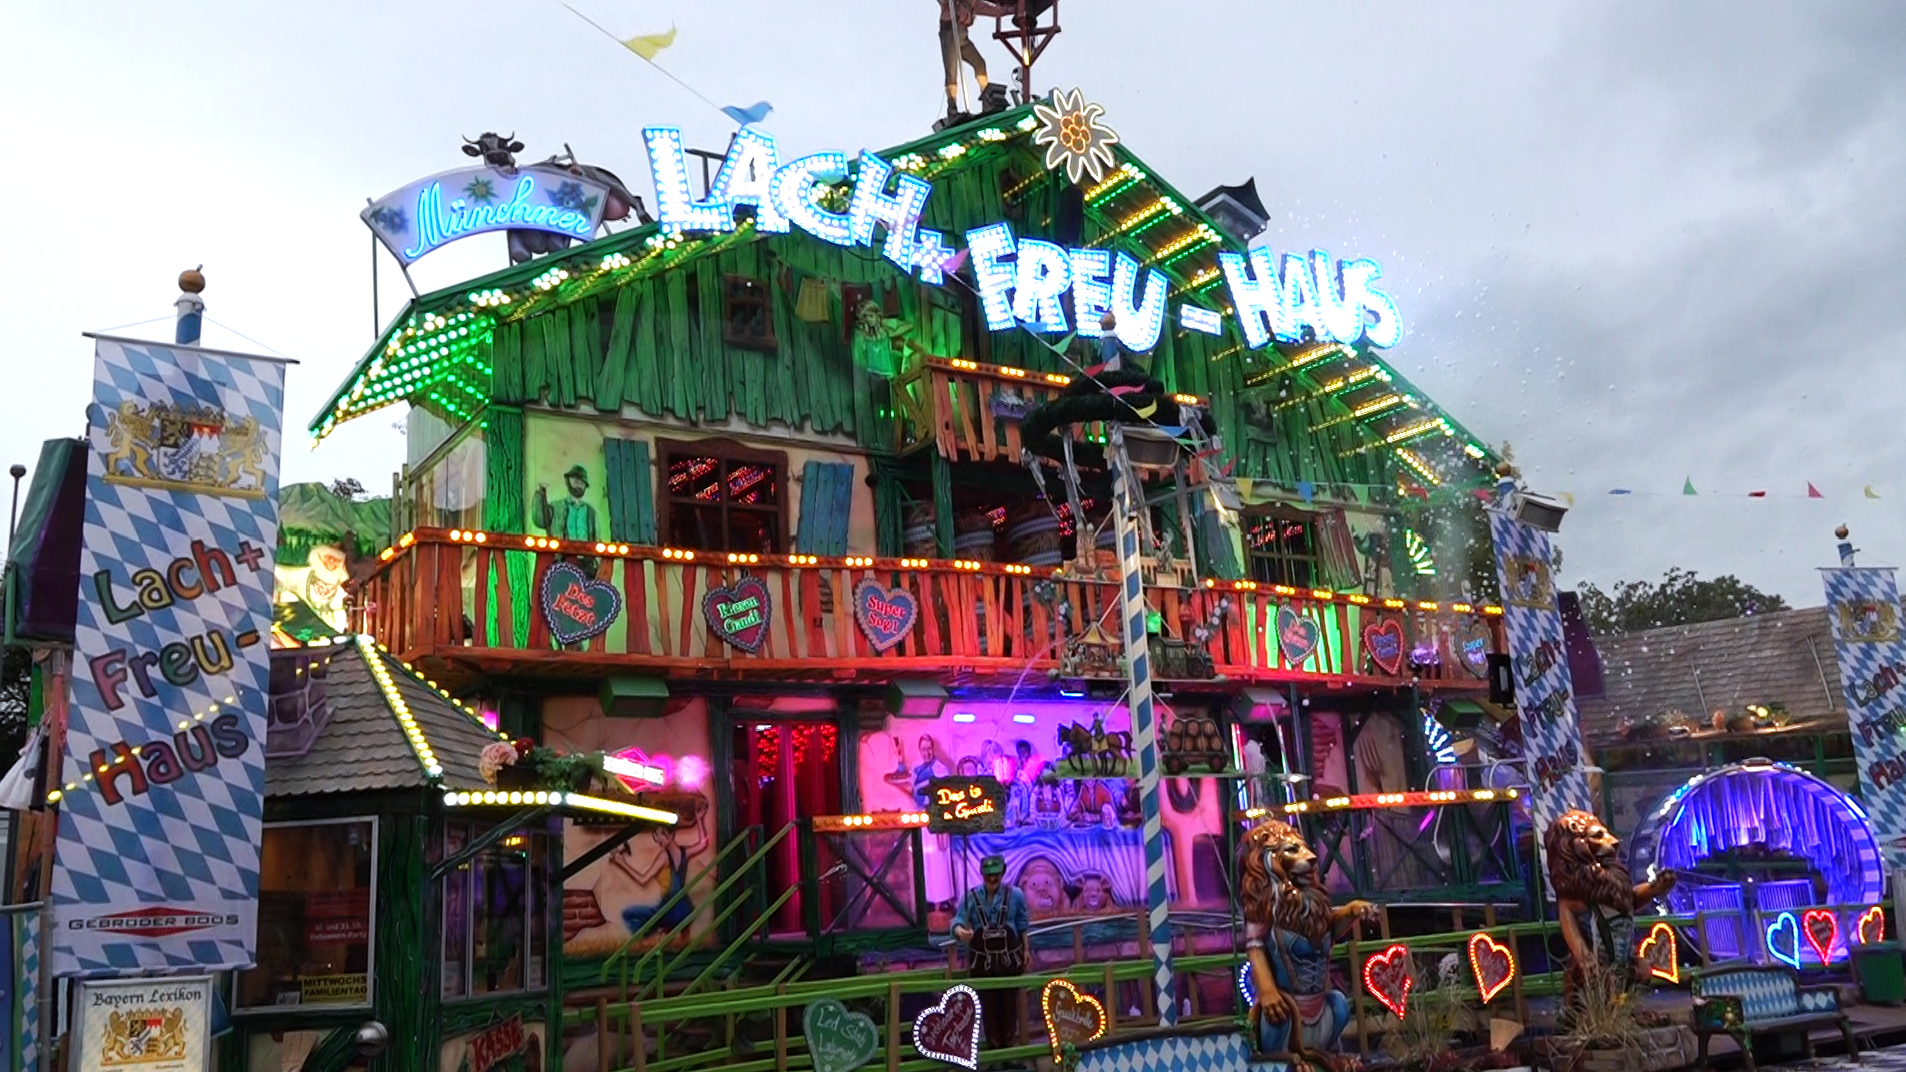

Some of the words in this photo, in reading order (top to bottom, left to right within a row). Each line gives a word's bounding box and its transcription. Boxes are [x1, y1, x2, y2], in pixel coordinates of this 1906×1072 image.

[866, 594, 906, 620] Super
[89, 713, 249, 806] Haus
[937, 788, 965, 805] Das
[303, 975, 368, 987] MITTWOCHS
[93, 991, 145, 1009] Bayern
[148, 987, 202, 1004] Lexikon
[473, 1014, 521, 1071] KASSE
